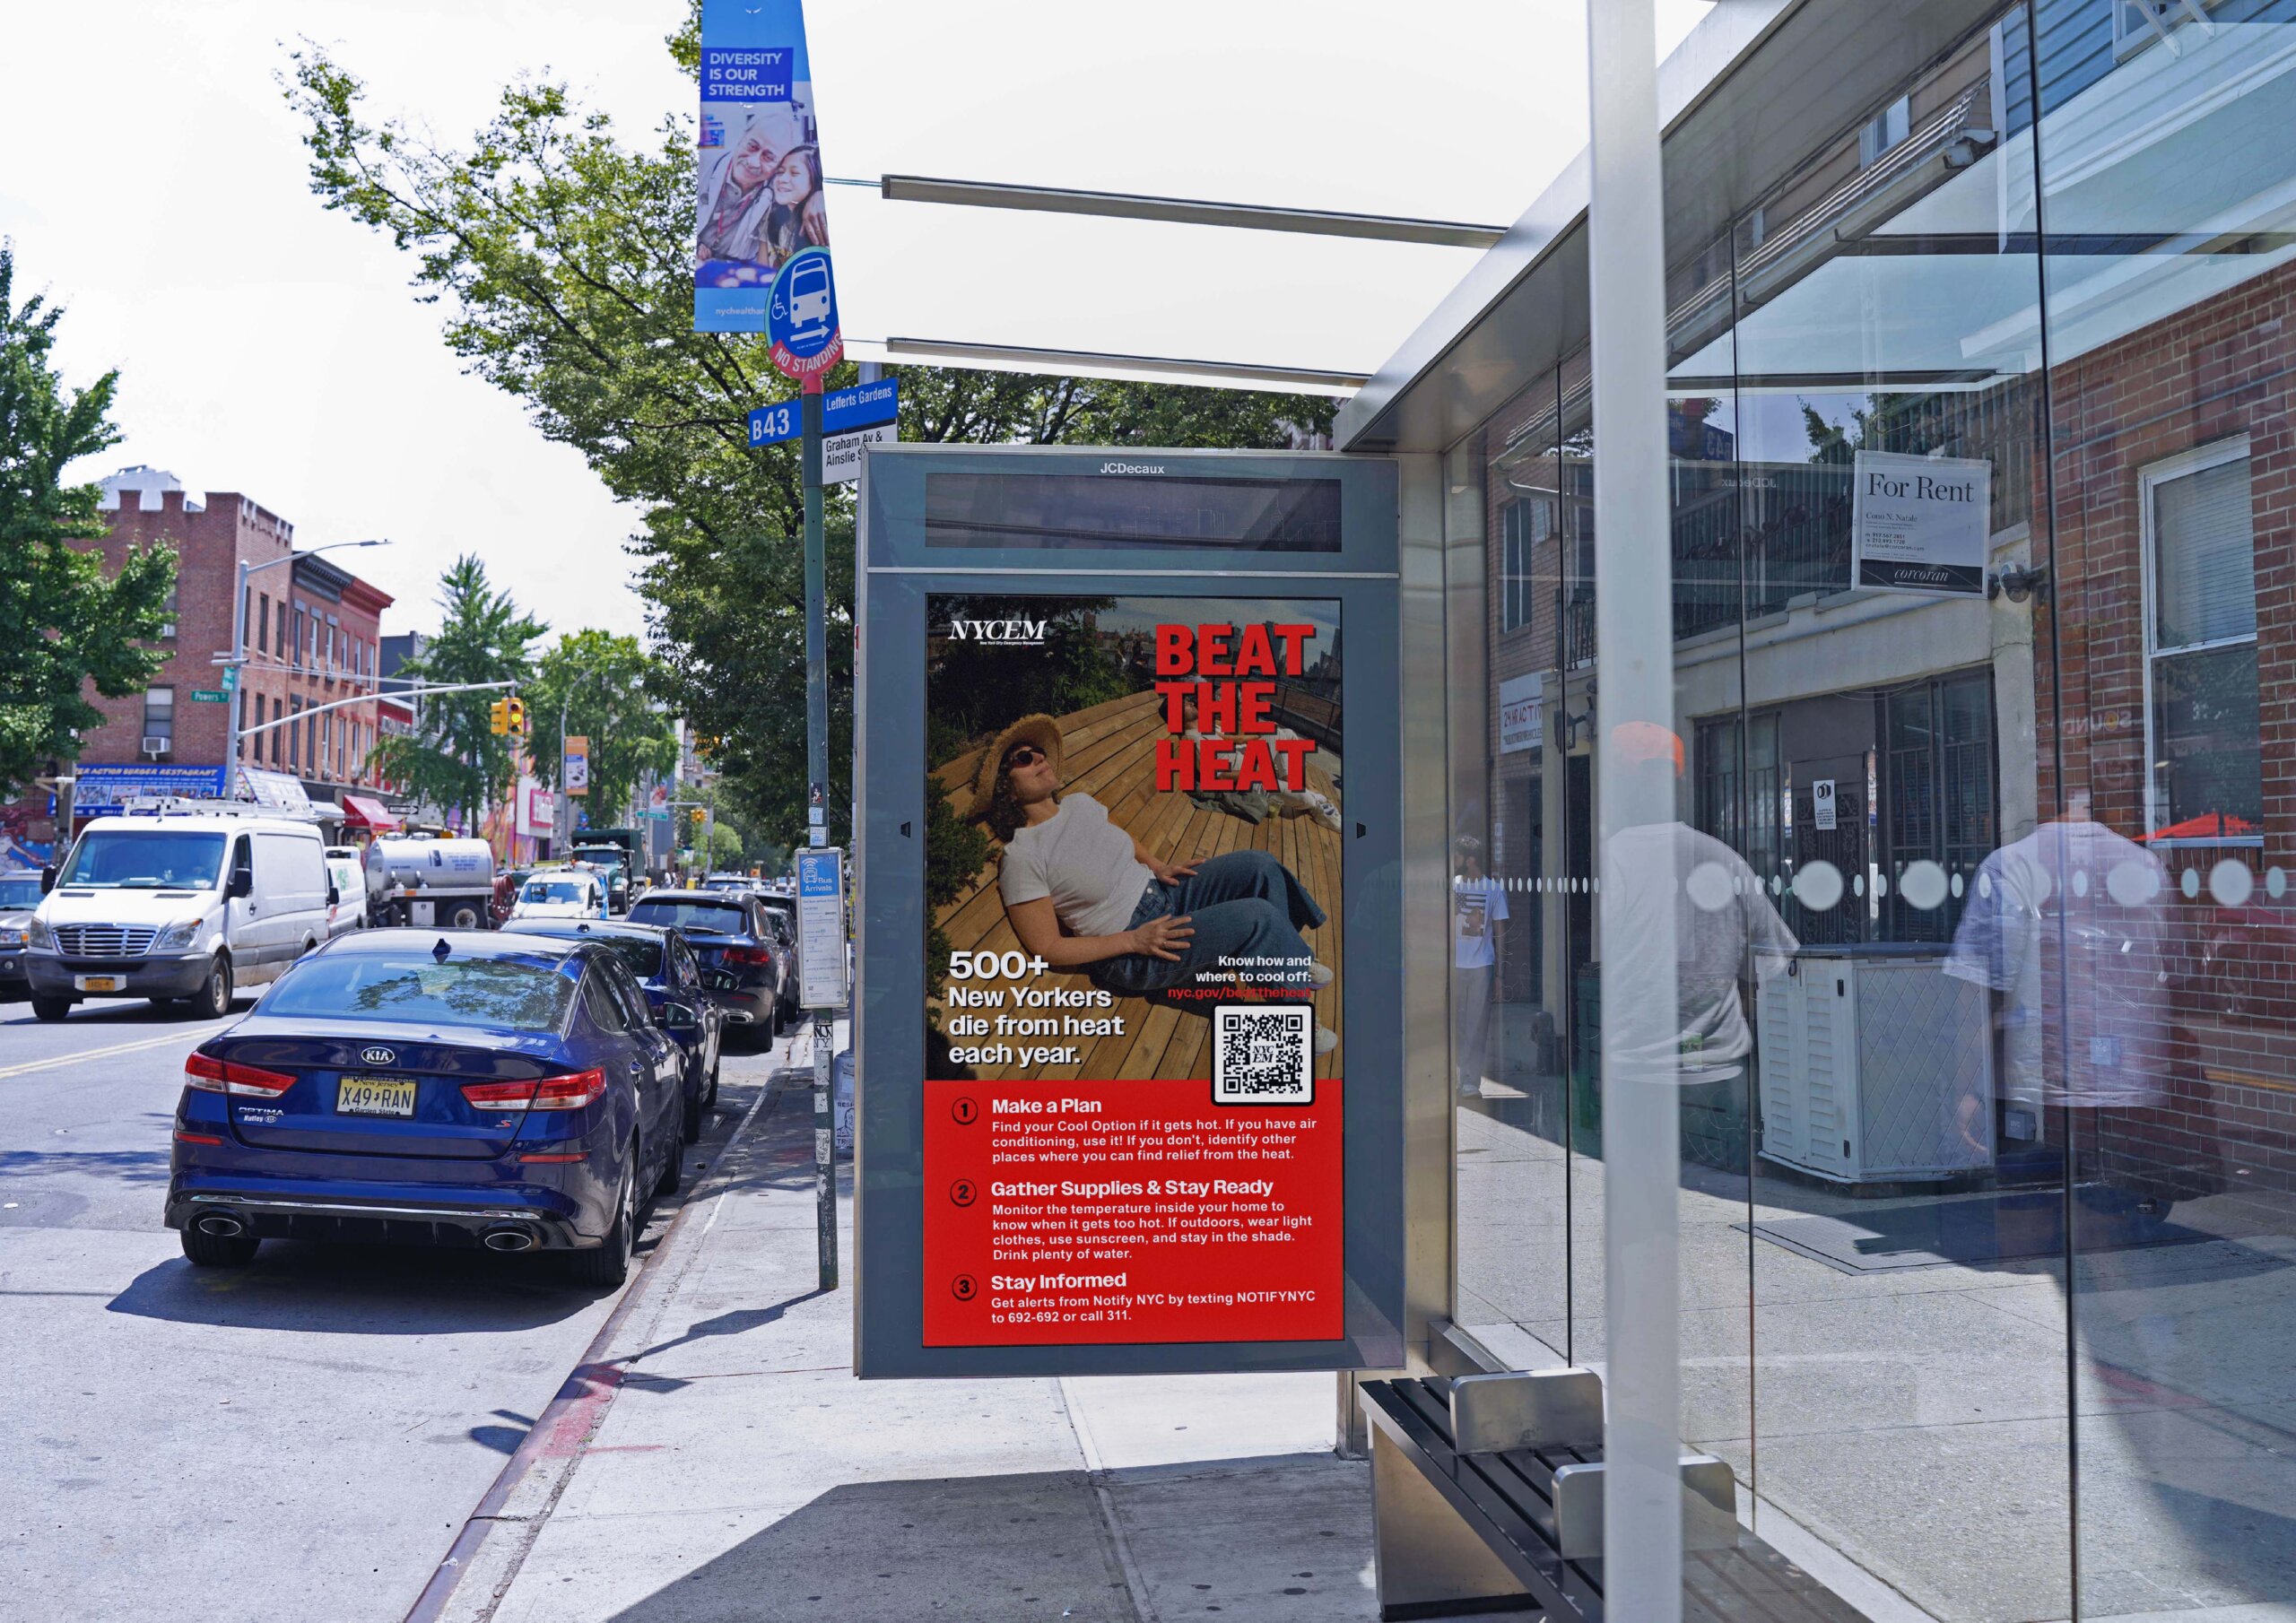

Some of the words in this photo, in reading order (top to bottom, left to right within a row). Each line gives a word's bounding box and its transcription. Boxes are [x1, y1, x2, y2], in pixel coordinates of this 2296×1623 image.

[709, 52, 782, 65] DIVERSITY
[709, 68, 722, 80] IS
[725, 68, 757, 81] OUR
[709, 83, 784, 96] STRENGTH
[774, 348, 791, 367] NO
[792, 333, 843, 372] STANDING
[826, 393, 857, 412] Lefferts
[858, 386, 892, 404] Gardens
[752, 408, 790, 441] B43
[826, 438, 860, 452] Graham
[862, 432, 874, 445] Av
[875, 430, 883, 442] &
[826, 451, 856, 467] Ainslie
[1100, 462, 1165, 473] JCDecaux
[1866, 473, 1909, 498] For
[1916, 476, 1975, 503] Rent
[1894, 568, 1949, 582] corcoran
[947, 620, 1048, 639] NYCEM
[1155, 624, 1315, 676] BEAT
[1155, 681, 1277, 733] THE
[123, 768, 157, 776] BURGER
[160, 768, 218, 777] RESTAURANT
[1155, 740, 1317, 791] HEAT
[804, 884, 833, 892] Arrivals
[949, 950, 1048, 979] 500+
[1218, 955, 1255, 967] Know
[1257, 955, 1284, 967] how
[1286, 955, 1311, 967] and
[1196, 971, 1236, 982] where
[1239, 971, 1254, 982] to
[1257, 971, 1284, 982] cool
[1286, 971, 1311, 982] off:
[949, 987, 1004, 1007] New
[1010, 987, 1112, 1007] Yorkers
[1168, 987, 1312, 1001] nyc.gov/beattheheat
[949, 1015, 989, 1036] die
[995, 1015, 1058, 1036] from
[1064, 1015, 1125, 1036] heat
[366, 1050, 389, 1061] KIA
[949, 1044, 1013, 1063] each
[1018, 1046, 1081, 1068] year.
[1252, 1045, 1274, 1054] NYC
[1252, 1054, 1274, 1063] EM
[342, 1086, 372, 1107] X49
[381, 1089, 412, 1109] RAN
[239, 1107, 284, 1115] OPTIMA
[992, 1098, 1042, 1114] Make
[1046, 1102, 1057, 1113] a
[1061, 1098, 1101, 1113] Plan
[992, 1121, 1021, 1133] Find
[1024, 1123, 1054, 1134] your
[1057, 1121, 1088, 1132] Cool
[1091, 1120, 1135, 1133] Option
[1140, 1120, 1149, 1130] if
[1152, 1120, 1161, 1130] it
[1164, 1120, 1193, 1133] gets
[1196, 1119, 1222, 1130] hot.
[1225, 1119, 1235, 1130] If
[1238, 1121, 1261, 1132] you
[1265, 1119, 1296, 1129] have
[1300, 1118, 1318, 1129] air
[992, 1136, 1079, 1148] conditioning,
[1083, 1138, 1106, 1147] use
[1110, 1136, 1123, 1146] it!
[1126, 1135, 1136, 1146] If
[1139, 1137, 1162, 1147] you
[1167, 1134, 1205, 1147] don't,
[1208, 1134, 1257, 1146] identify
[1262, 1133, 1296, 1144] other
[992, 1151, 1036, 1164] places
[1039, 1151, 1079, 1162] where
[1083, 1152, 1107, 1164] you
[1110, 1152, 1134, 1161] can
[1137, 1150, 1162, 1160] find
[1166, 1150, 1200, 1160] relief
[1204, 1150, 1234, 1159] from
[1238, 1149, 1257, 1159] the
[1262, 1149, 1294, 1159] heat.
[991, 1181, 1057, 1196] Gather
[1061, 1180, 1144, 1198] Supplies
[1147, 1180, 1161, 1195] &
[1165, 1179, 1210, 1197] Stay
[1213, 1179, 1274, 1197] Ready
[993, 1204, 1044, 1215] Monitor
[1047, 1204, 1067, 1214] the
[1070, 1202, 1151, 1216] temperature
[1155, 1202, 1195, 1213] inside
[1198, 1204, 1228, 1215] your
[1231, 1202, 1268, 1211] home
[1271, 1202, 1284, 1211] to
[993, 1219, 1027, 1230] know
[1031, 1219, 1066, 1229] when
[1070, 1219, 1078, 1229] it
[1082, 1219, 1110, 1231] gets
[1114, 1219, 1135, 1228] too
[1139, 1218, 1164, 1228] hot.
[1168, 1218, 1177, 1228] If
[1180, 1217, 1244, 1228] outdoors,
[1248, 1218, 1279, 1227] wear
[1283, 1216, 1312, 1228] light
[993, 1235, 1045, 1245] clothes,
[1048, 1236, 1073, 1245] use
[1076, 1234, 1148, 1245] sunscreen,
[1152, 1232, 1177, 1243] and
[1180, 1233, 1208, 1245] stay
[1212, 1232, 1223, 1243] in
[1227, 1231, 1248, 1242] the
[1251, 1231, 1295, 1242] shade.
[993, 1249, 1029, 1260] Drink
[1032, 1249, 1073, 1262] plenty
[1076, 1248, 1091, 1259] of
[1093, 1249, 1133, 1259] water.
[991, 1275, 1036, 1292] Stay
[1039, 1272, 1127, 1289] Informed
[991, 1298, 1014, 1308] Get
[1018, 1297, 1056, 1307] alerts
[1059, 1296, 1090, 1306] from
[1093, 1295, 1133, 1308] Notify
[1136, 1294, 1164, 1305] NYC
[1168, 1294, 1184, 1306] by
[1187, 1293, 1233, 1306] texting
[1237, 1290, 1316, 1303] NOTIFYNYC
[991, 1314, 1004, 1324] to
[1008, 1312, 1059, 1324] 692-692
[1063, 1313, 1076, 1322] or
[1080, 1311, 1103, 1322] call
[1107, 1310, 1132, 1321] 311.
